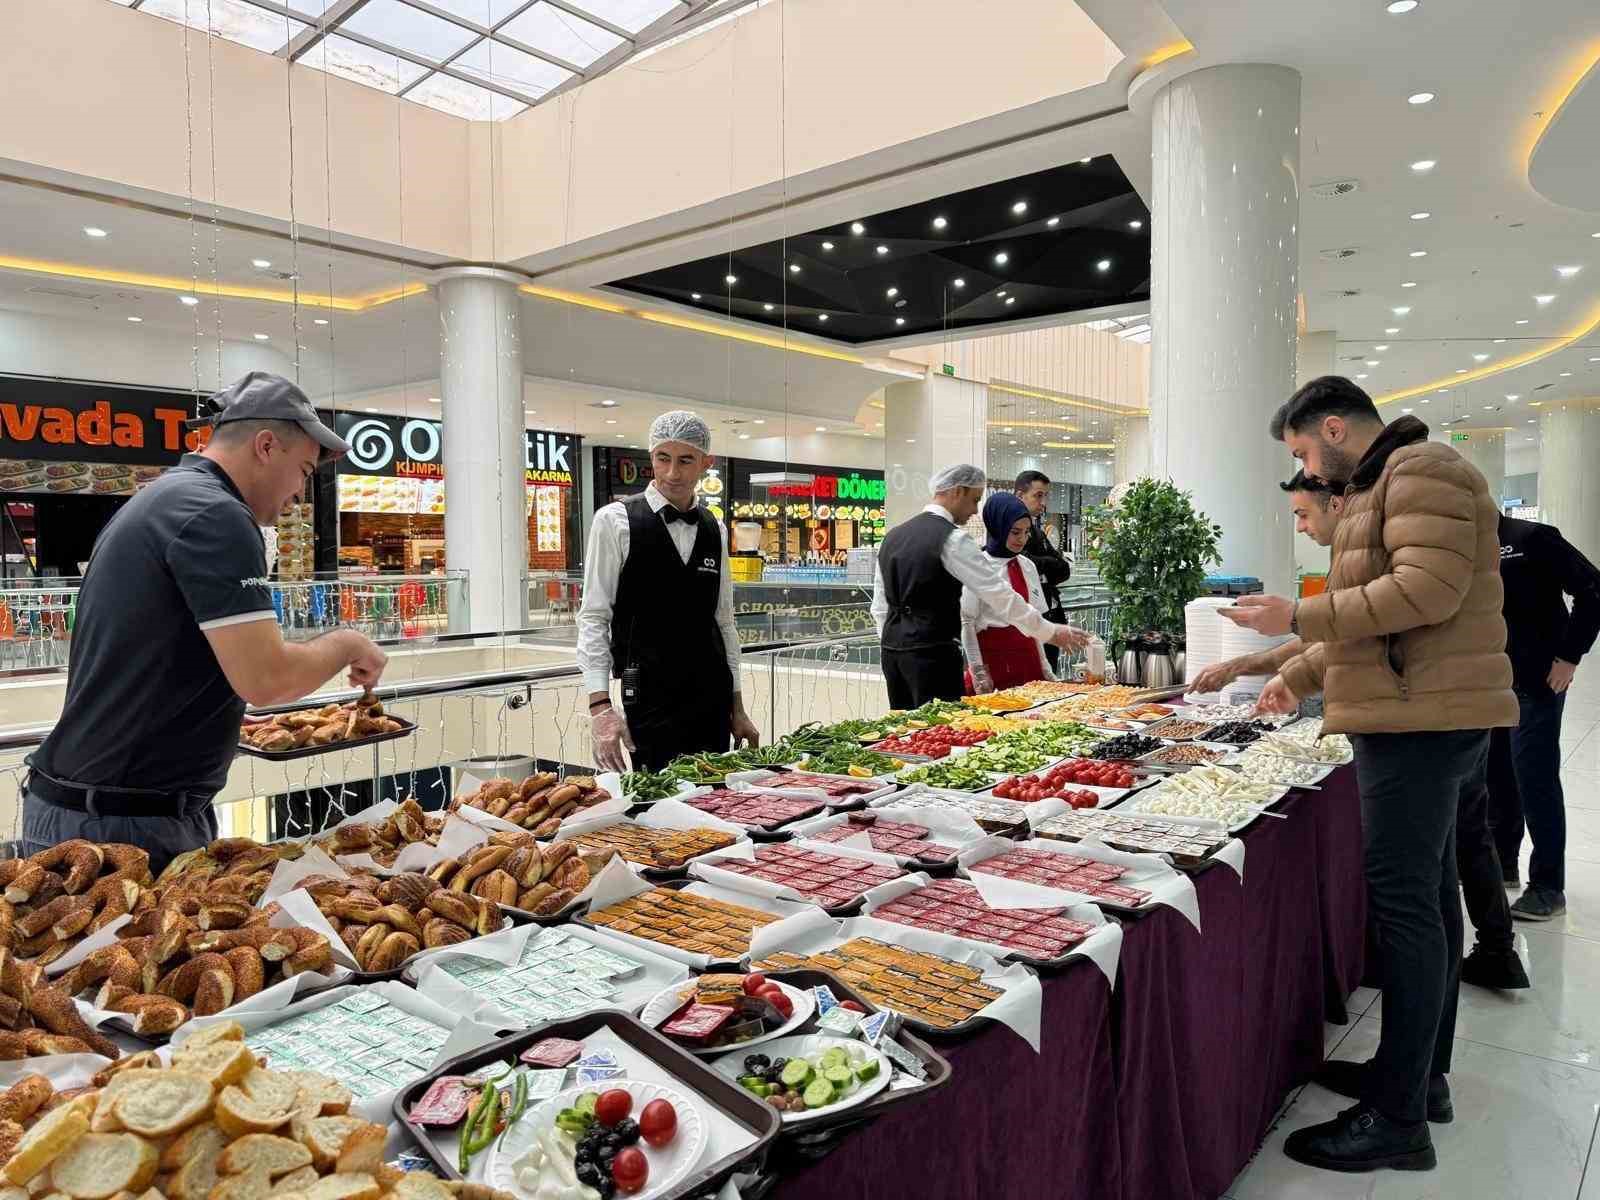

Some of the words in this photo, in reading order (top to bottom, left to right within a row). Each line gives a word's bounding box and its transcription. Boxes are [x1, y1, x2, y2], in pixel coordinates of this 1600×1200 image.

[0, 401, 144, 448] vada
[155, 408, 213, 451] Ta
[396, 461, 444, 476] KUMPİ
[525, 470, 573, 483] AKARNA
